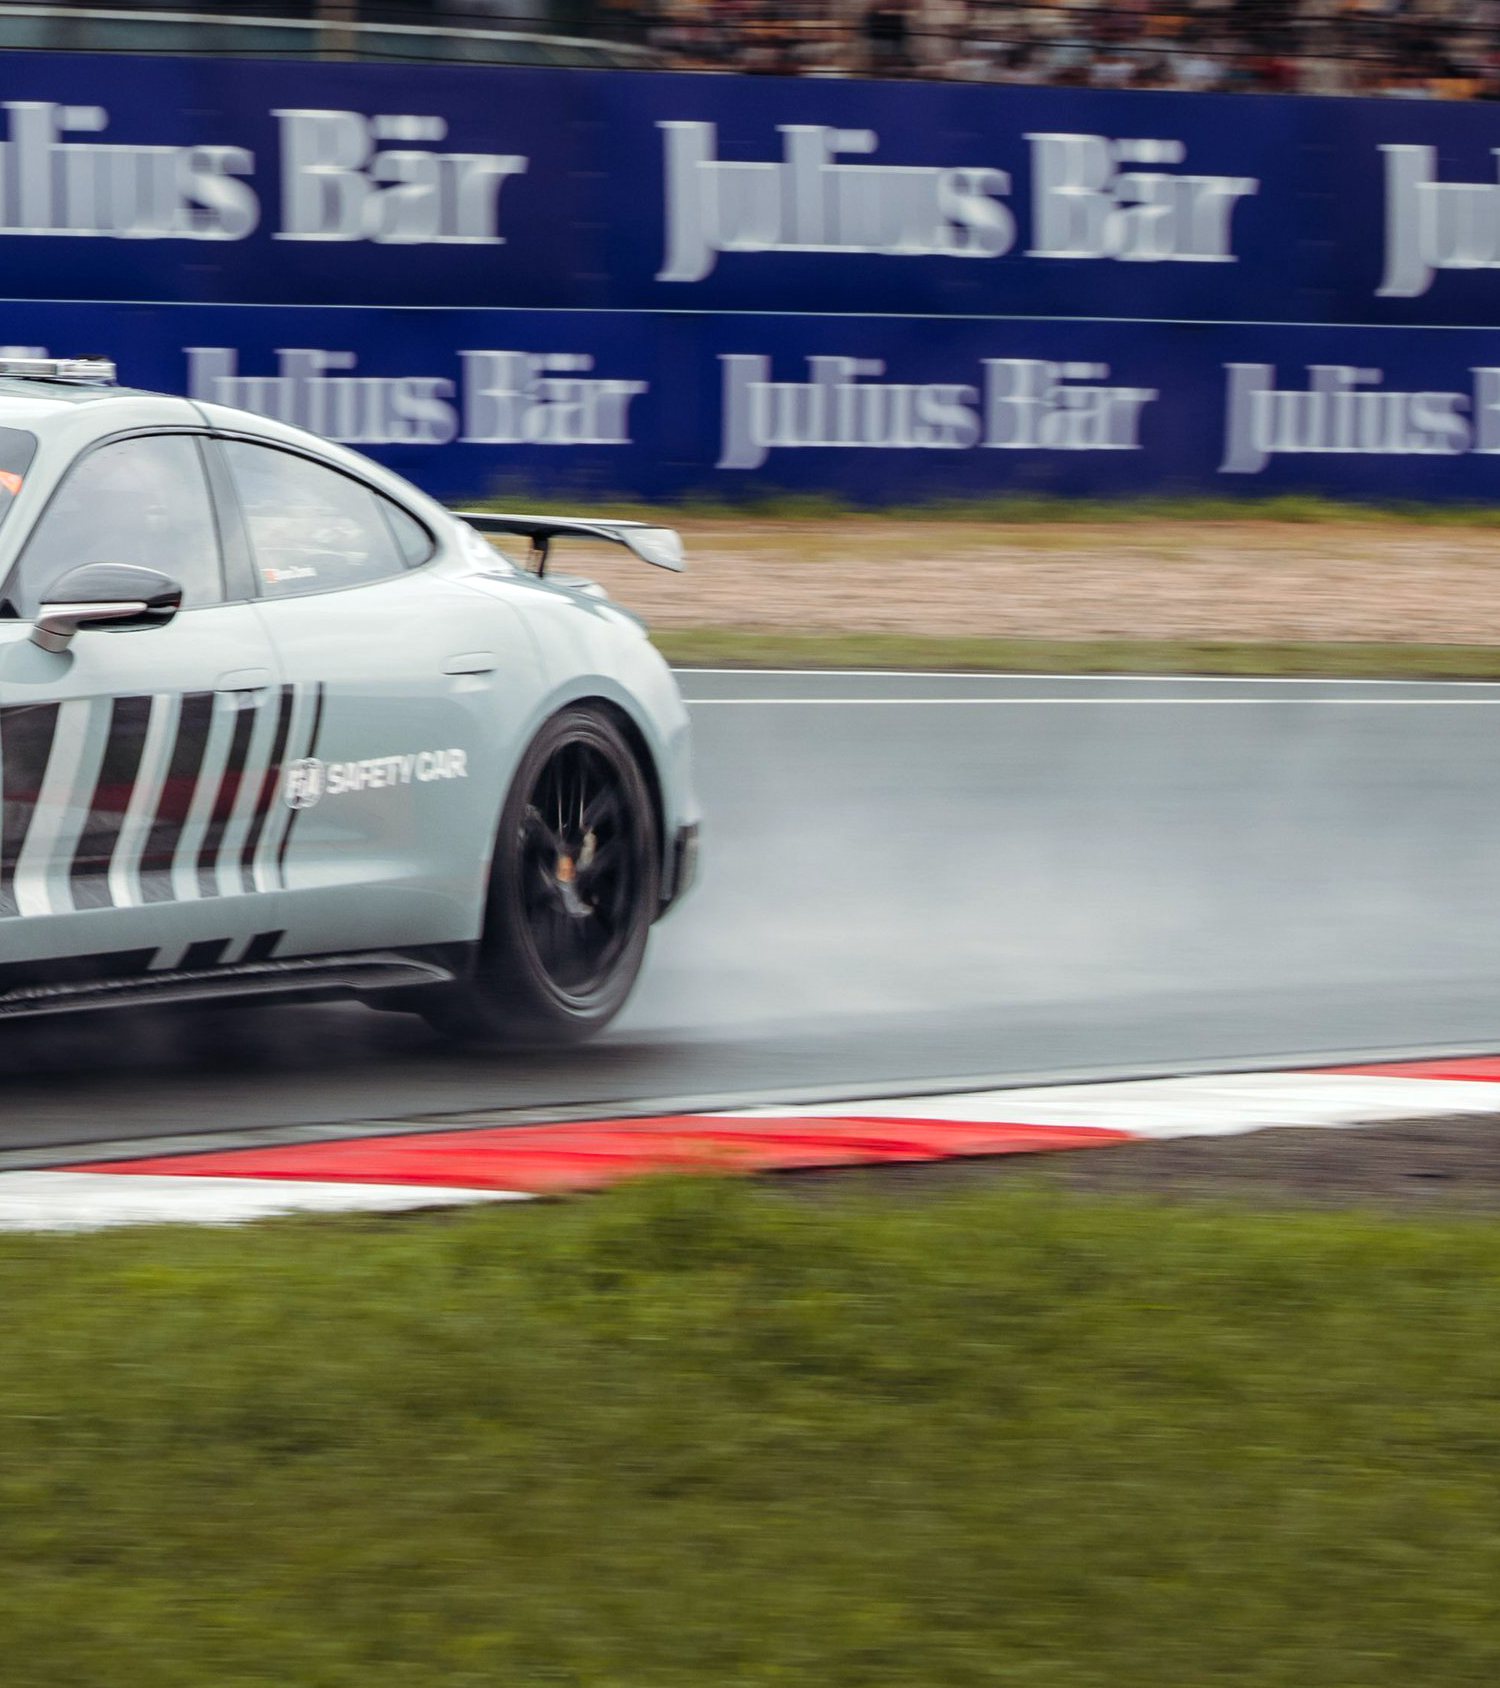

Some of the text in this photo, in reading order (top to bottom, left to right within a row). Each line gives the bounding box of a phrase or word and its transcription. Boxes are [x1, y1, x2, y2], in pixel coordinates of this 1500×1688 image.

[269, 107, 529, 246] Bär
[654, 119, 1259, 283] Julius Bär
[457, 349, 649, 446] Bär
[716, 352, 1160, 470] Julius Bär
[1218, 361, 1472, 474] Julius
[325, 754, 415, 795] SAFETY
[415, 748, 469, 783] CAR
